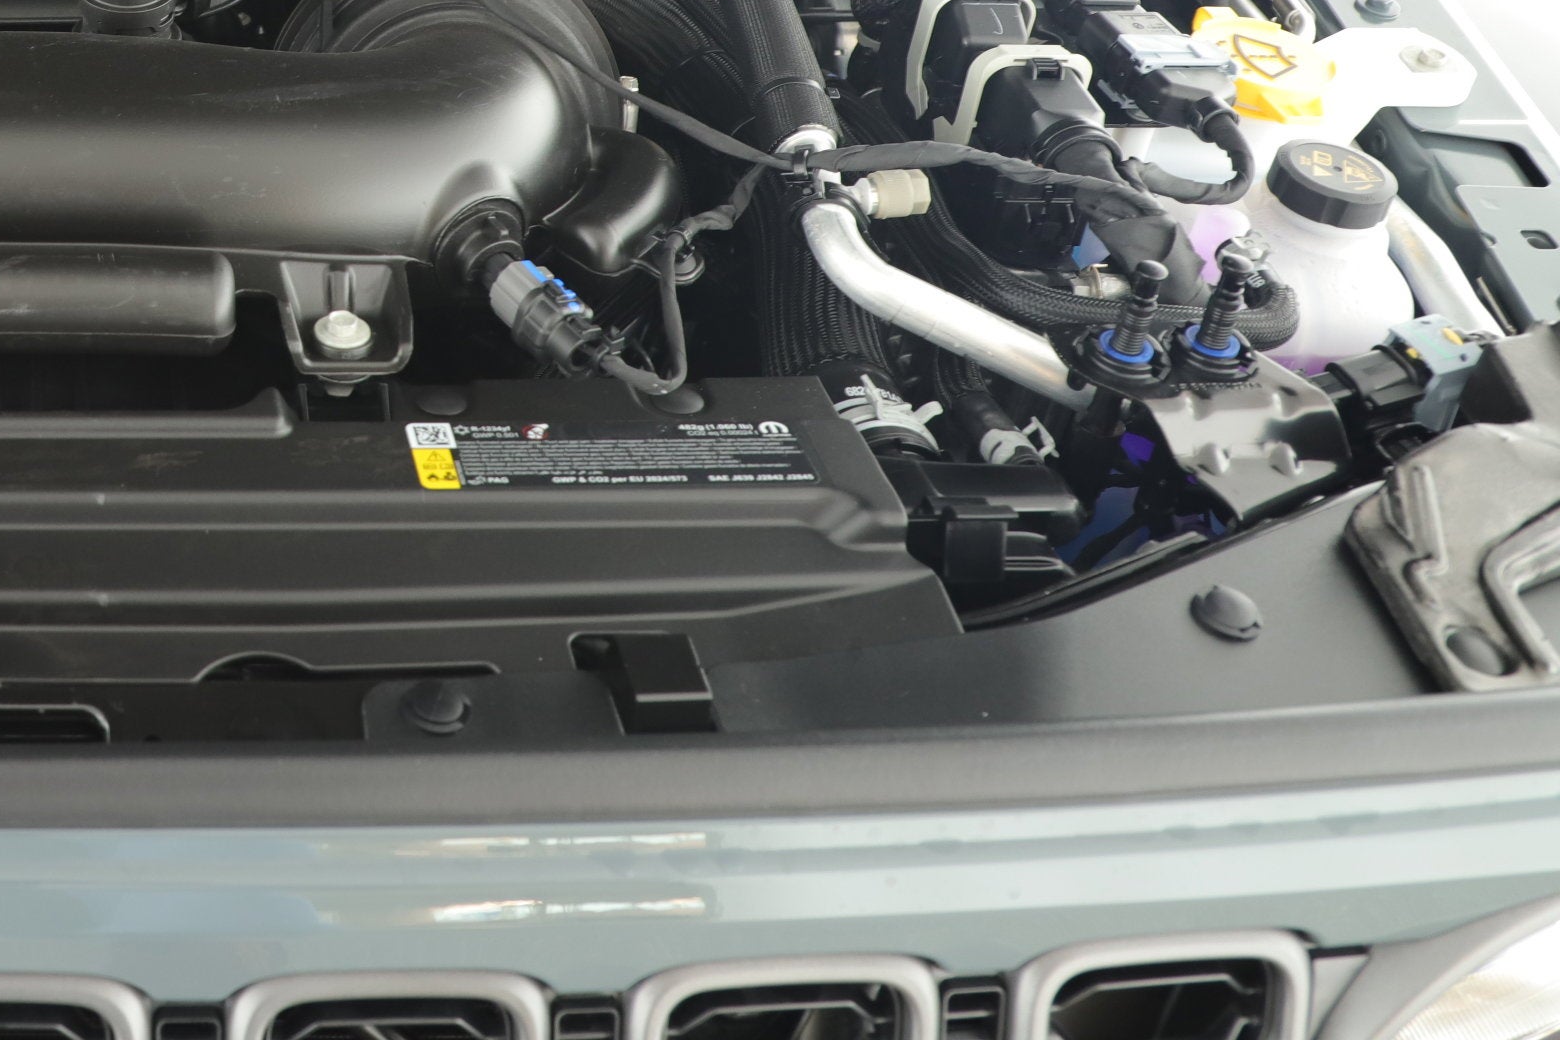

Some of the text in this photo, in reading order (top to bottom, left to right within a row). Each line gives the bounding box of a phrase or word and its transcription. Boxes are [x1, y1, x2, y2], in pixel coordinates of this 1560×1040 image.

[487, 476, 510, 484] PAG
[628, 475, 644, 483] EU
[708, 474, 730, 482] SAE
